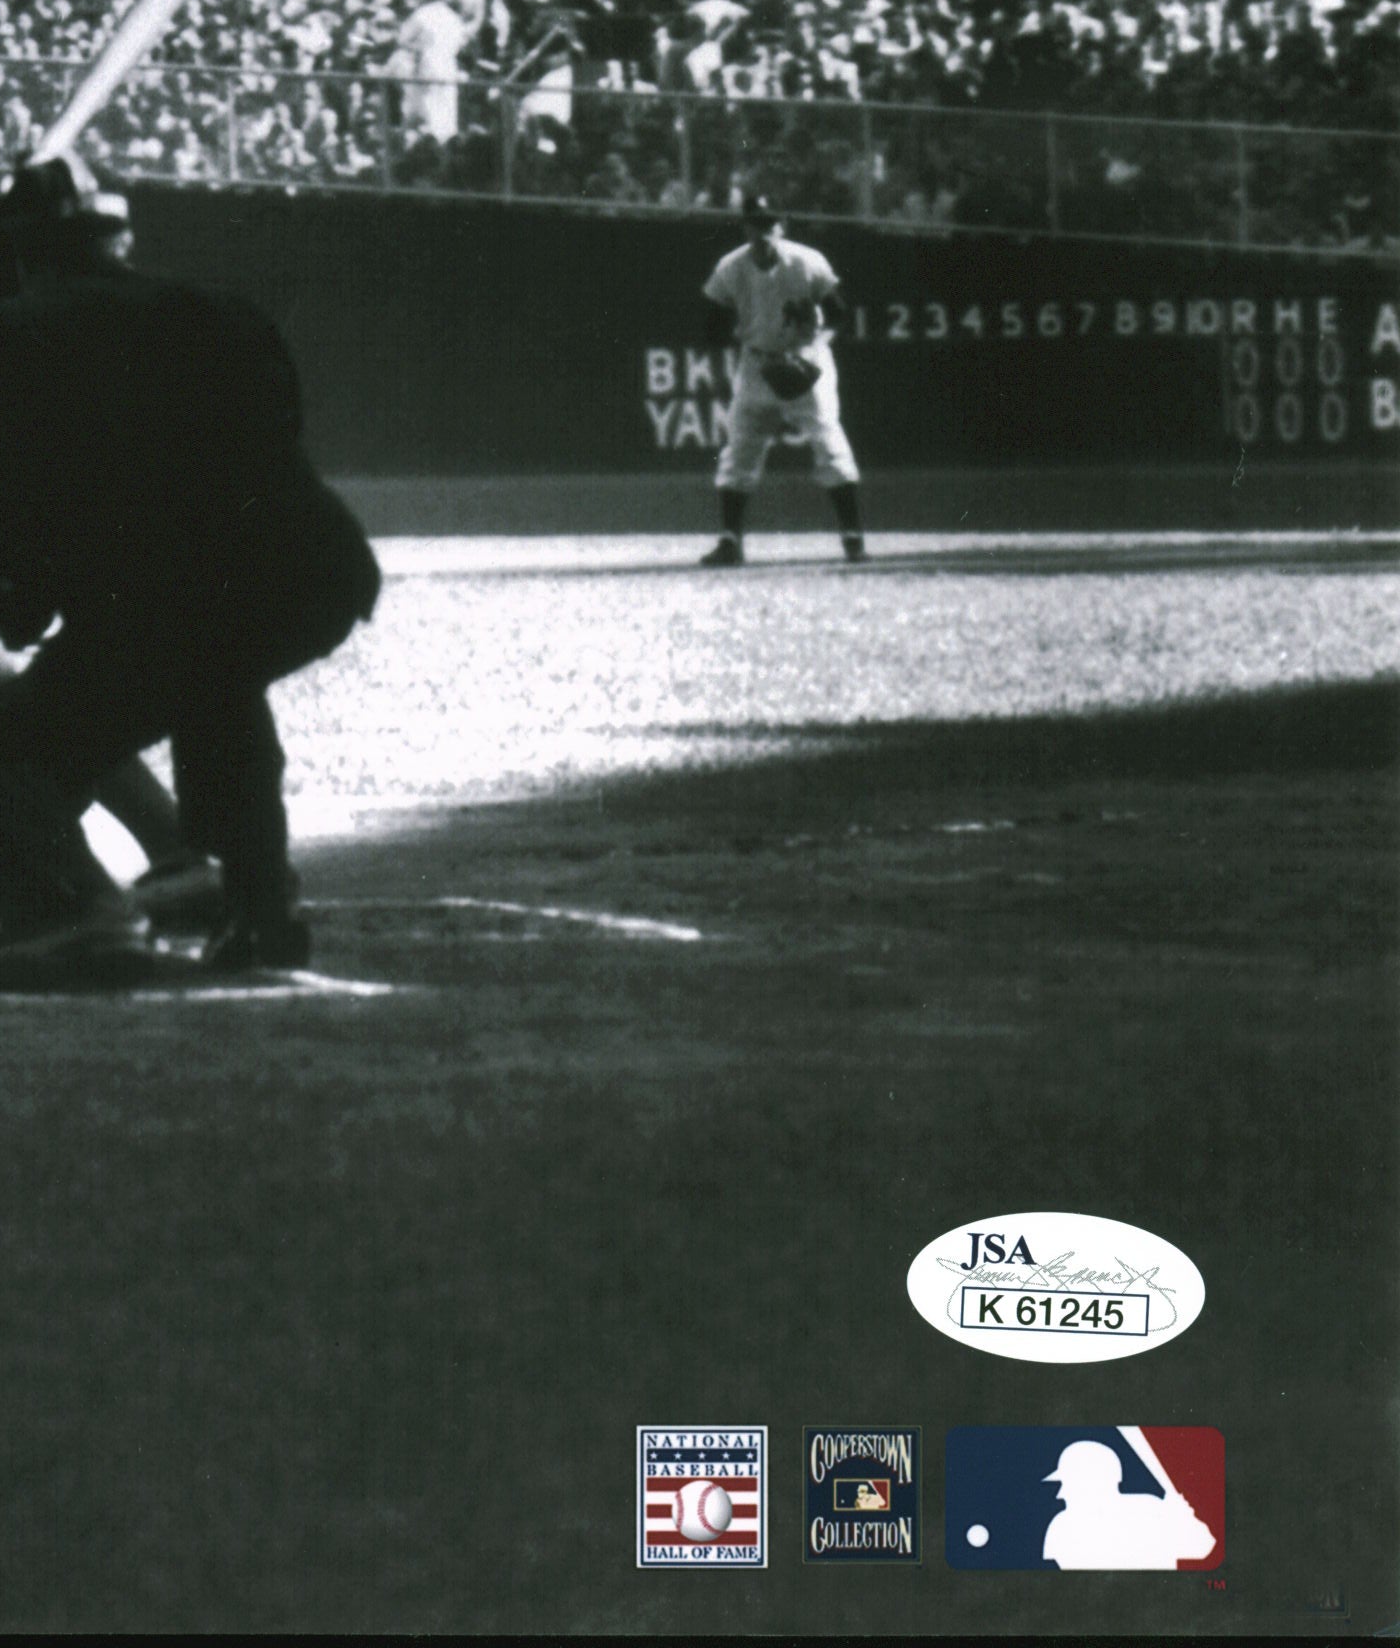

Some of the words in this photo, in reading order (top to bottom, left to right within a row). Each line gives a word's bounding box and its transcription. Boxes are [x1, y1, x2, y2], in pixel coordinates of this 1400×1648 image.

[887, 304, 910, 340] 2
[925, 302, 949, 339] 3
[960, 304, 983, 338] 4
[1002, 303, 1023, 337] 5
[1037, 302, 1062, 336] 6
[1078, 302, 1096, 335] 7
[1115, 300, 1138, 336] 8
[1152, 300, 1177, 334] 9
[1232, 300, 1255, 334] R
[1274, 300, 1301, 334] H
[1317, 297, 1338, 334] E
